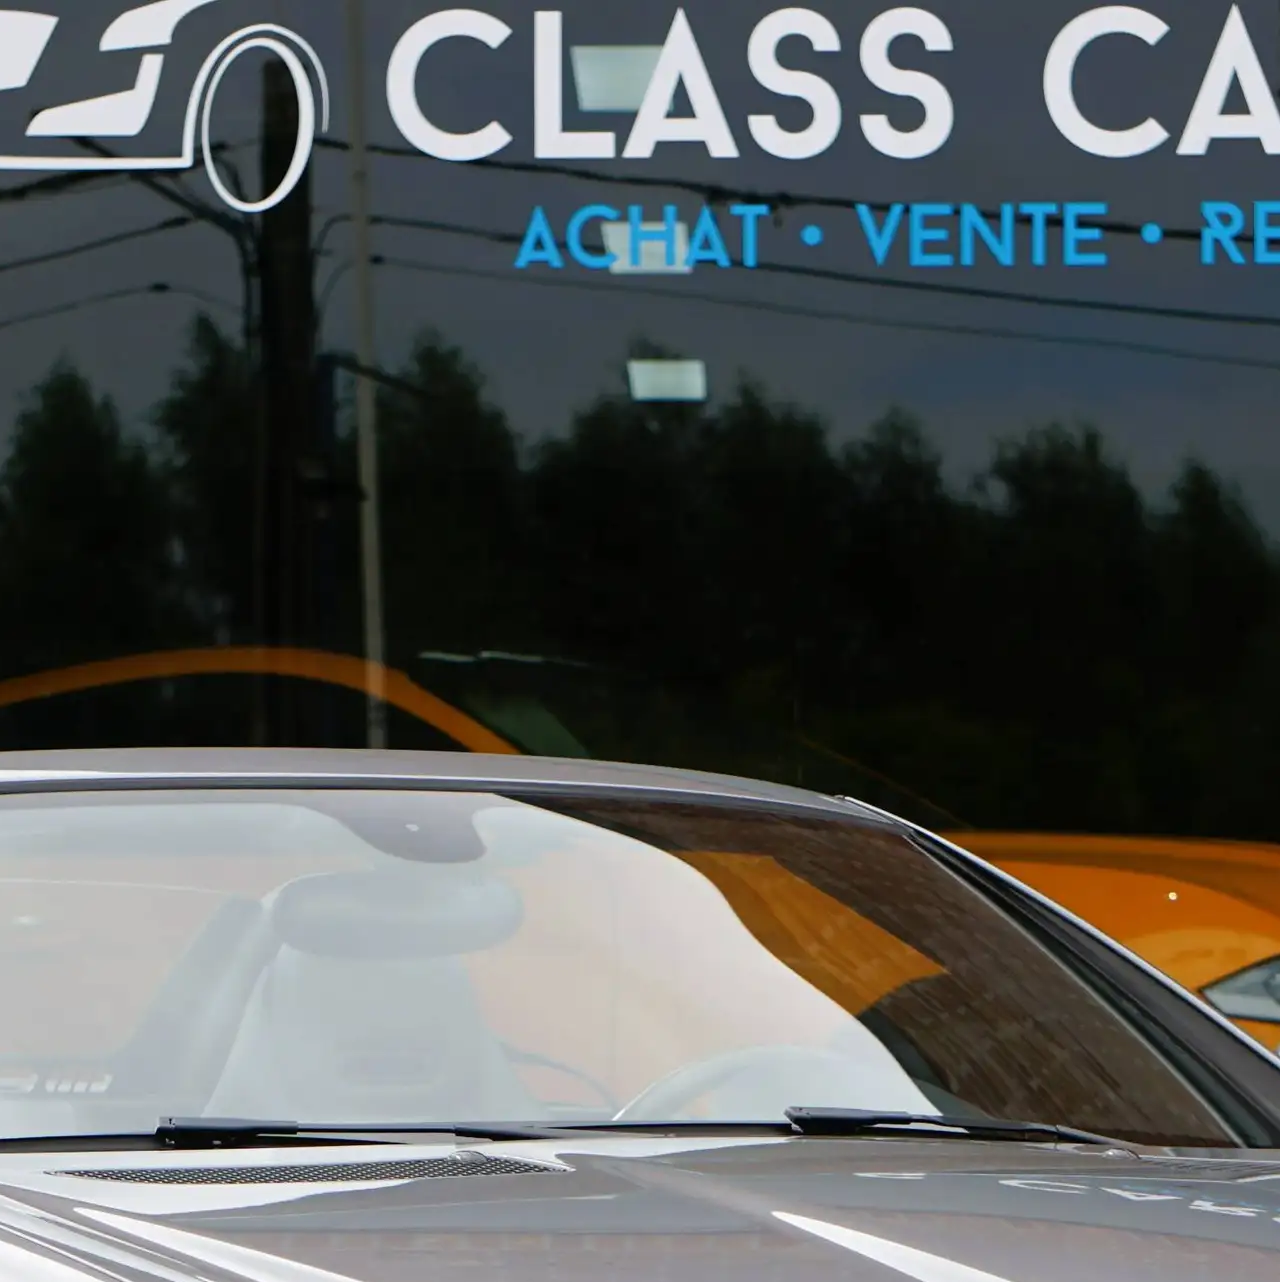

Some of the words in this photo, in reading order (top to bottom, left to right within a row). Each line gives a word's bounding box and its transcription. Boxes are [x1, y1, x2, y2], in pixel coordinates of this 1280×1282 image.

[386, 6, 954, 161] CLASS
[514, 203, 770, 269] ACHAT
[856, 201, 1109, 267] VENTE
